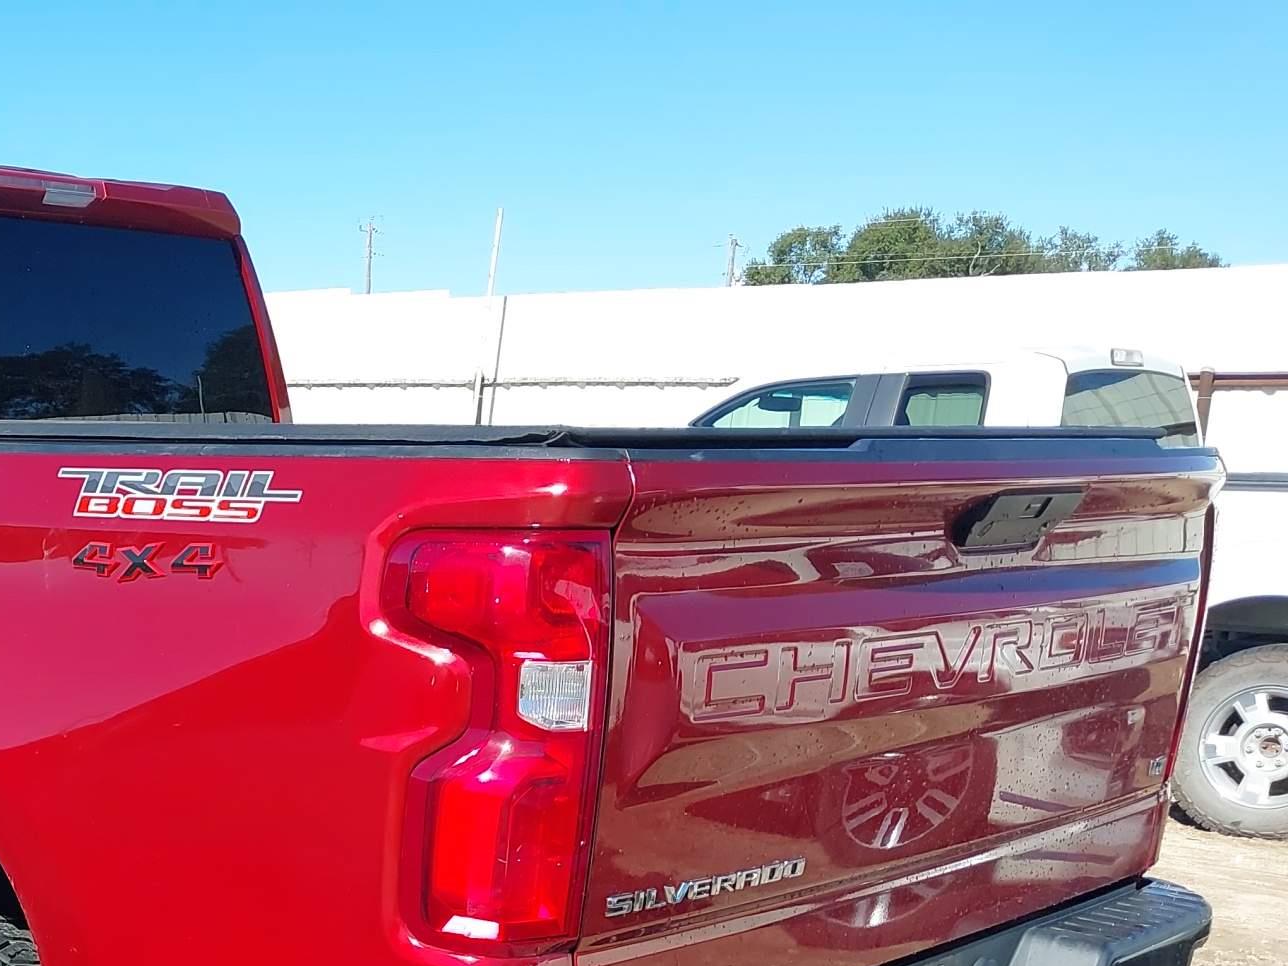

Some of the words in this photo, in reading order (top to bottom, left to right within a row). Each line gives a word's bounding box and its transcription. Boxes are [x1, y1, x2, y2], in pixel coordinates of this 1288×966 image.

[58, 467, 303, 502] TRAIL
[73, 494, 266, 523] BOSS
[691, 590, 1194, 723] CHEVROLET
[604, 857, 807, 917] SILVERADO
